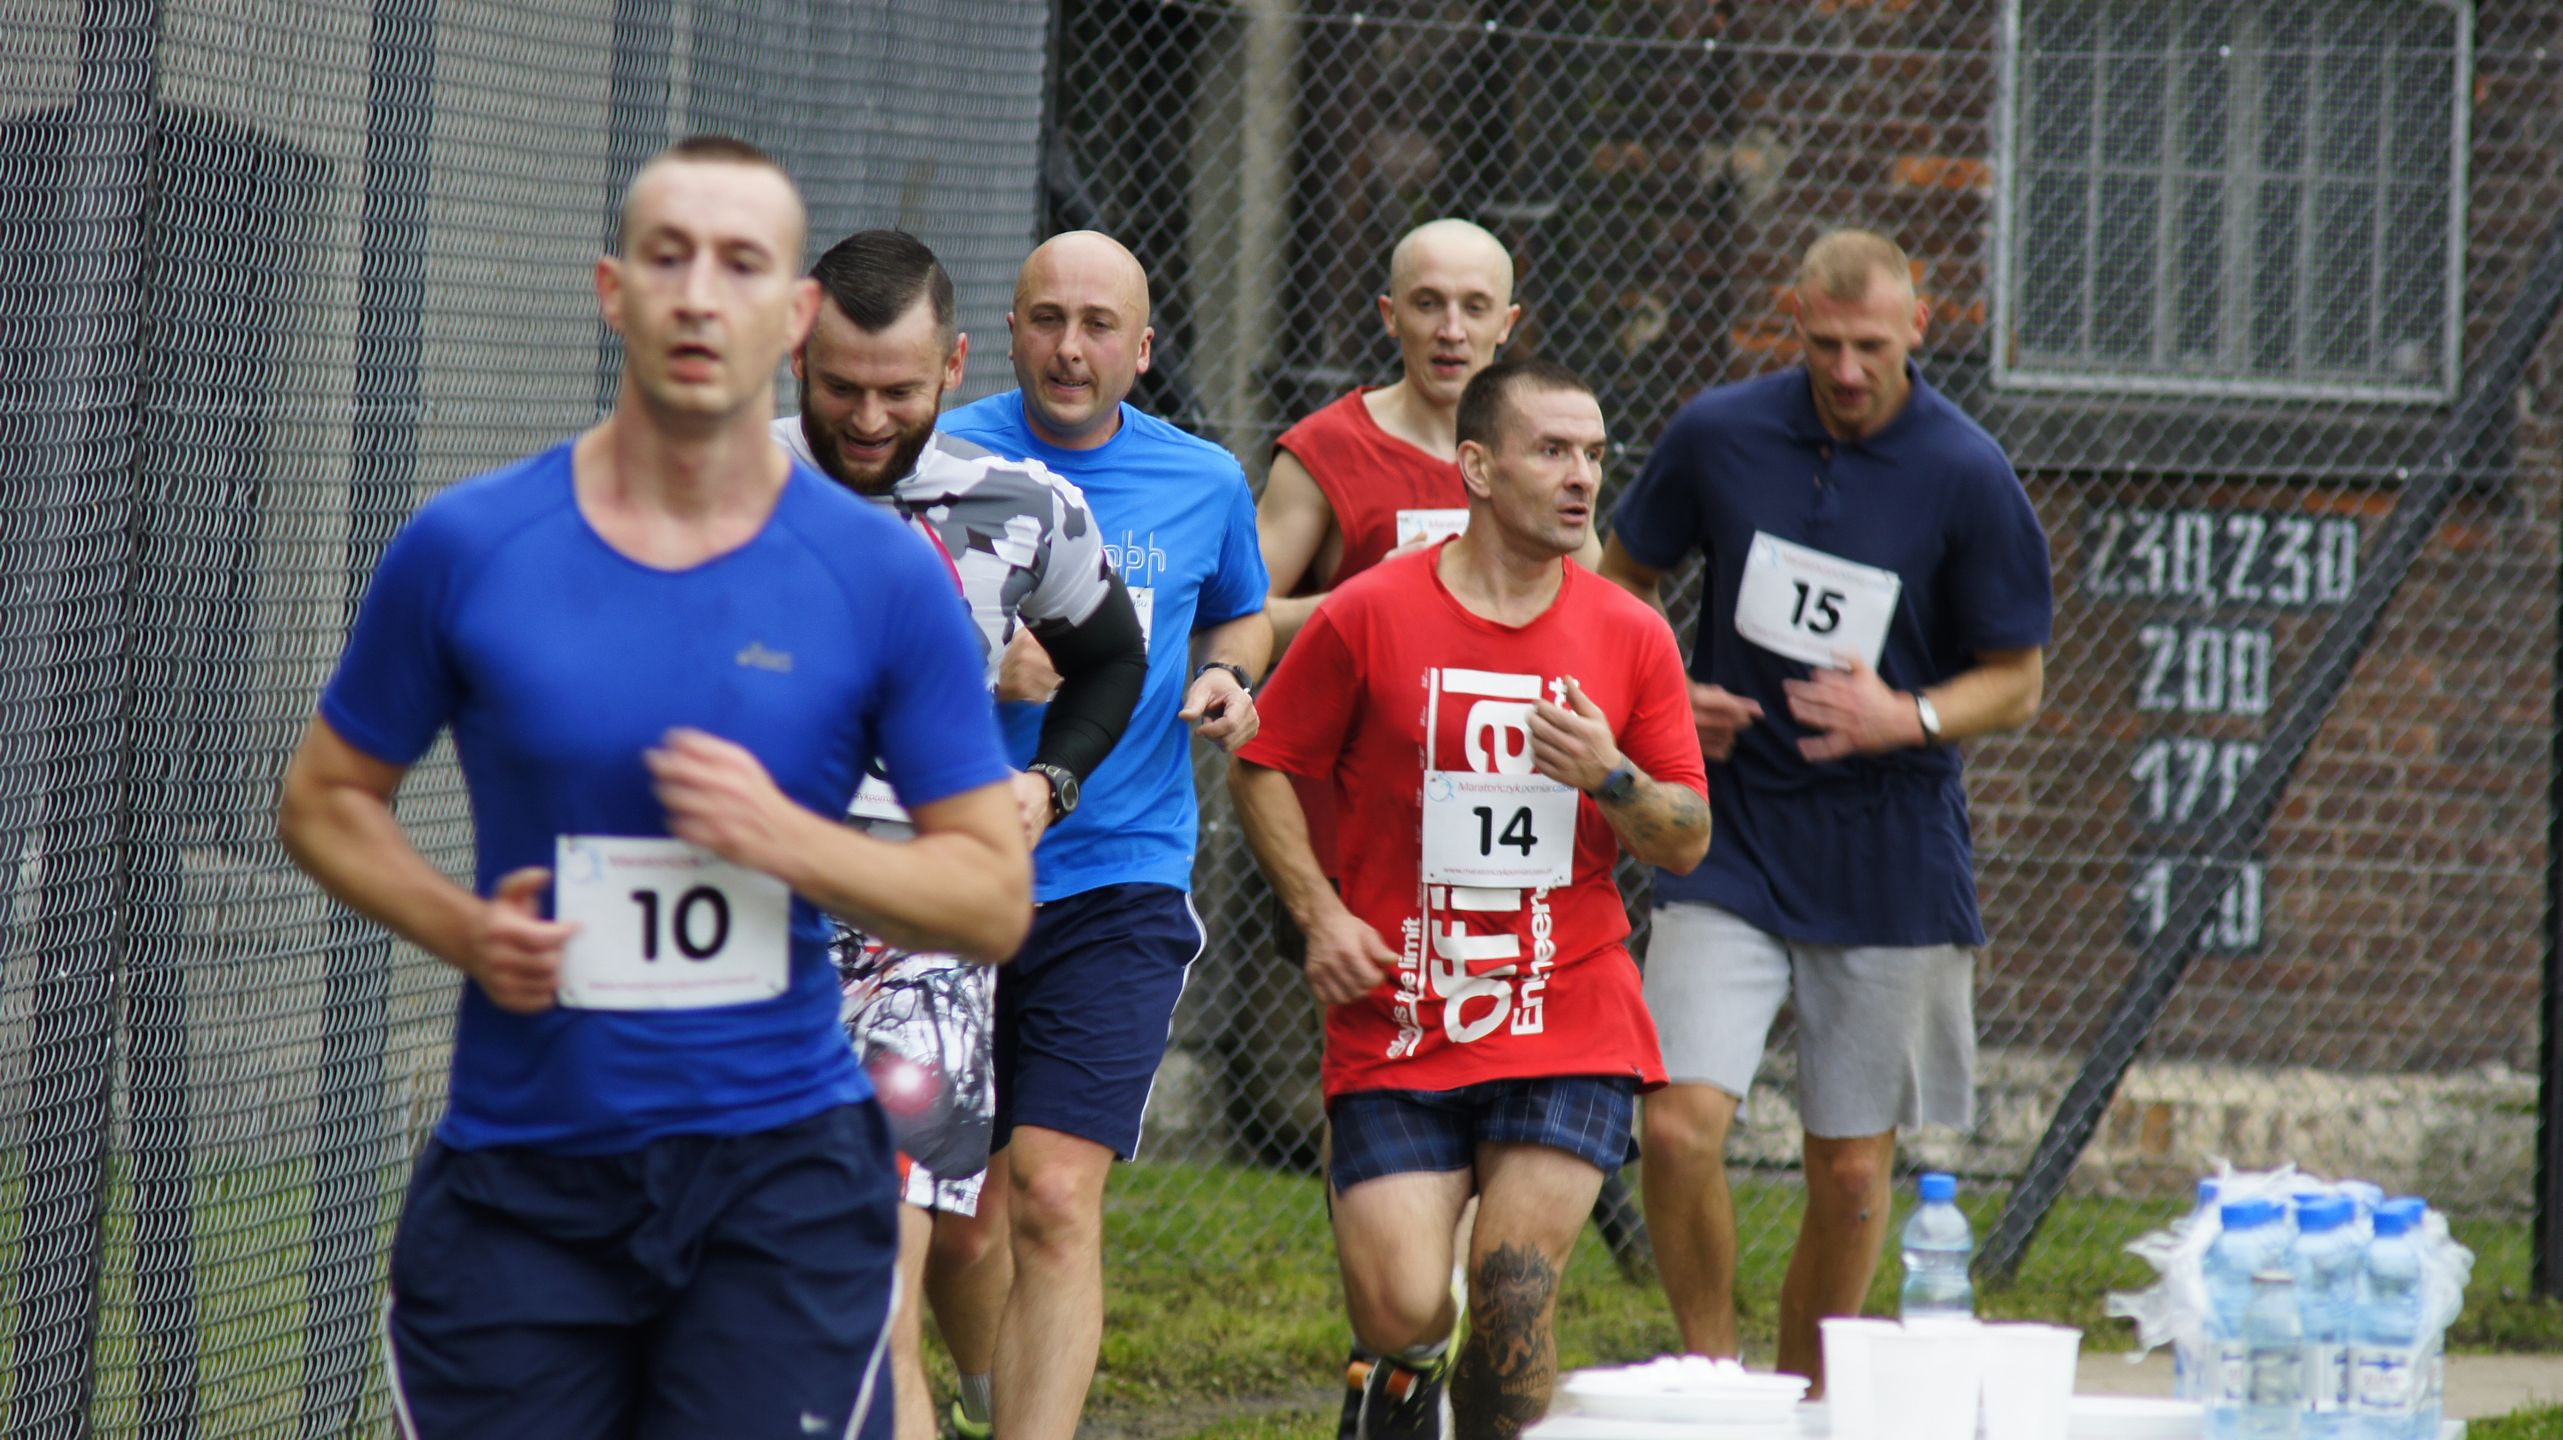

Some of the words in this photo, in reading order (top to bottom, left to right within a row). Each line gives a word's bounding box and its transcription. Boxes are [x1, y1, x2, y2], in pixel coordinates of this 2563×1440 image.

[1791, 579, 1848, 636] 15
[2137, 625, 2272, 715] 200
[1472, 806, 1538, 857] 14
[631, 884, 730, 962] 10
[2131, 858, 2264, 948] 10
[1398, 917, 1421, 969] limit
